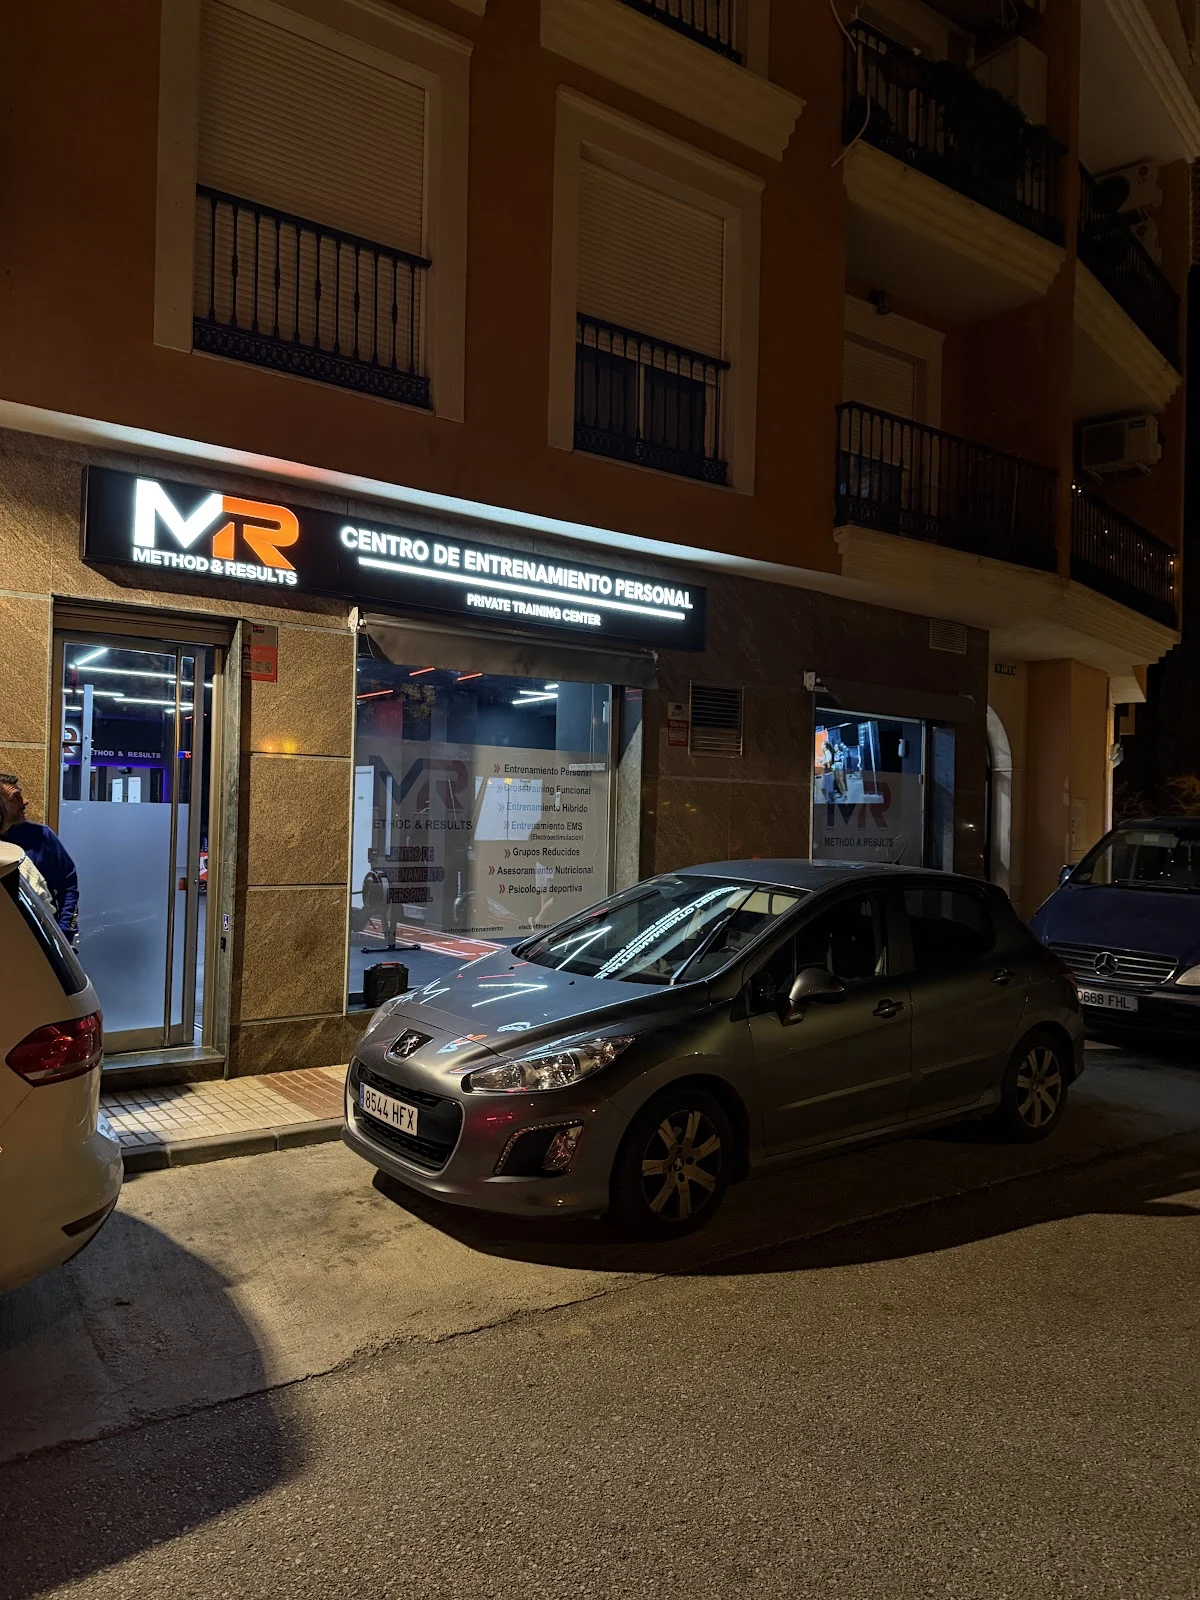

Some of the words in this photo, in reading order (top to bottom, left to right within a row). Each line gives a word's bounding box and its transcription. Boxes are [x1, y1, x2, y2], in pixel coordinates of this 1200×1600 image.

[134, 478, 299, 570] MR
[133, 547, 209, 573] METHOD
[210, 559, 224, 574] &
[225, 561, 298, 586] RESULTS
[340, 526, 429, 561] CENTRO
[433, 543, 461, 568] DE
[464, 549, 612, 595] ENTRENAMIENTO
[615, 578, 693, 609] PERSONAL
[467, 593, 511, 612] PRIVATE
[513, 601, 562, 620] TRAINING
[562, 610, 601, 626] CENTER
[89, 749, 115, 758] ETHOD
[127, 751, 161, 759] RESULTS
[504, 764, 558, 775] Entrenamiento
[560, 767, 592, 777] Personal
[503, 784, 554, 796] Crosstraining
[556, 785, 591, 795] Funcional
[507, 802, 560, 812] Entrenamiento
[414, 820, 422, 829] &
[425, 820, 473, 830] RESULTS
[511, 820, 565, 831] Entrenamiento
[566, 822, 583, 831] EMS
[824, 837, 855, 847] METHOD
[855, 838, 862, 847] &
[863, 837, 894, 847] RESULTS
[512, 847, 540, 858] Grupos
[542, 847, 580, 856] Reducidos
[497, 866, 553, 875] Asesoramiento
[555, 865, 594, 875] Nutricional
[549, 884, 583, 894] deportiva
[386, 887, 433, 904] PERSONAL
[1077, 990, 1104, 1005] 0668
[1108, 995, 1130, 1009] FHL
[365, 1090, 389, 1119] 8544
[392, 1102, 414, 1131] HFX
